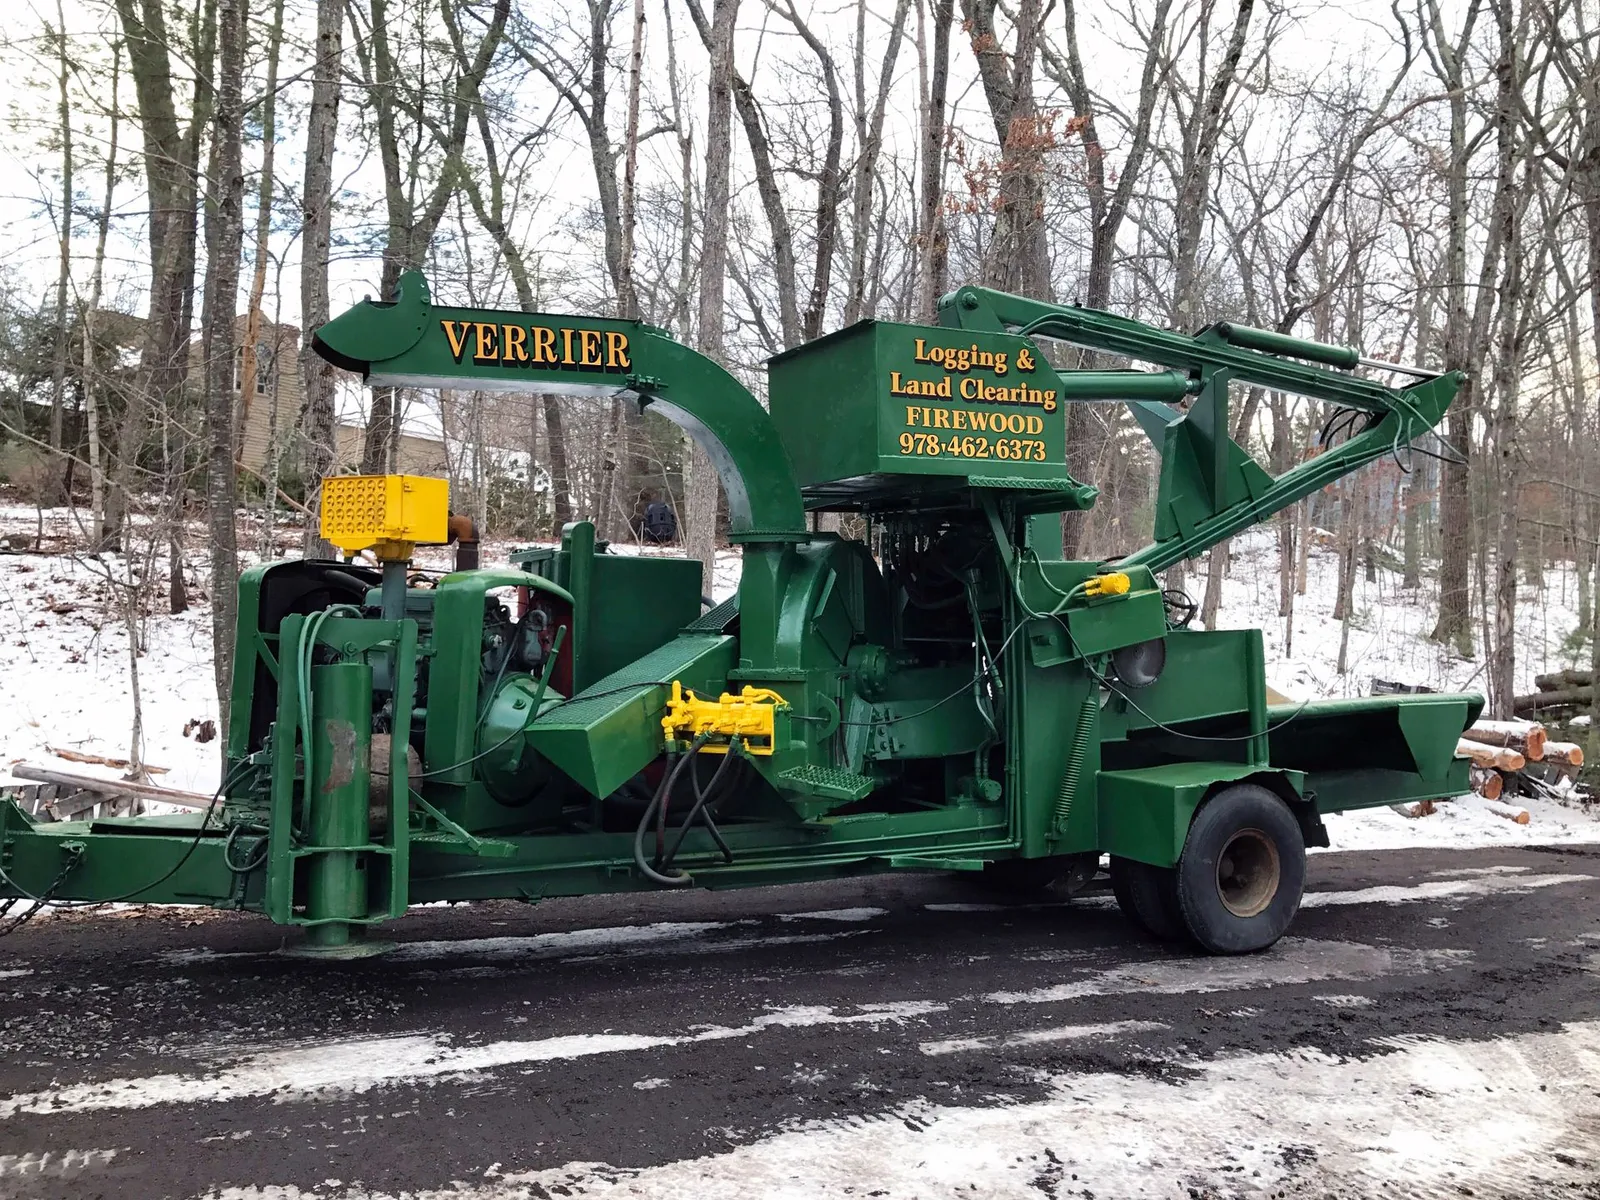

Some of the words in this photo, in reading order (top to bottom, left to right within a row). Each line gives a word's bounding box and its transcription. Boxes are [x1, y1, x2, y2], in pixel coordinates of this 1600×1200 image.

[440, 319, 632, 371] VERRIER
[914, 338, 1008, 374] Logging
[1016, 348, 1035, 371] &
[890, 371, 952, 398] Land
[959, 378, 1057, 411] Clearing
[905, 405, 1044, 435] FIREWOOD
